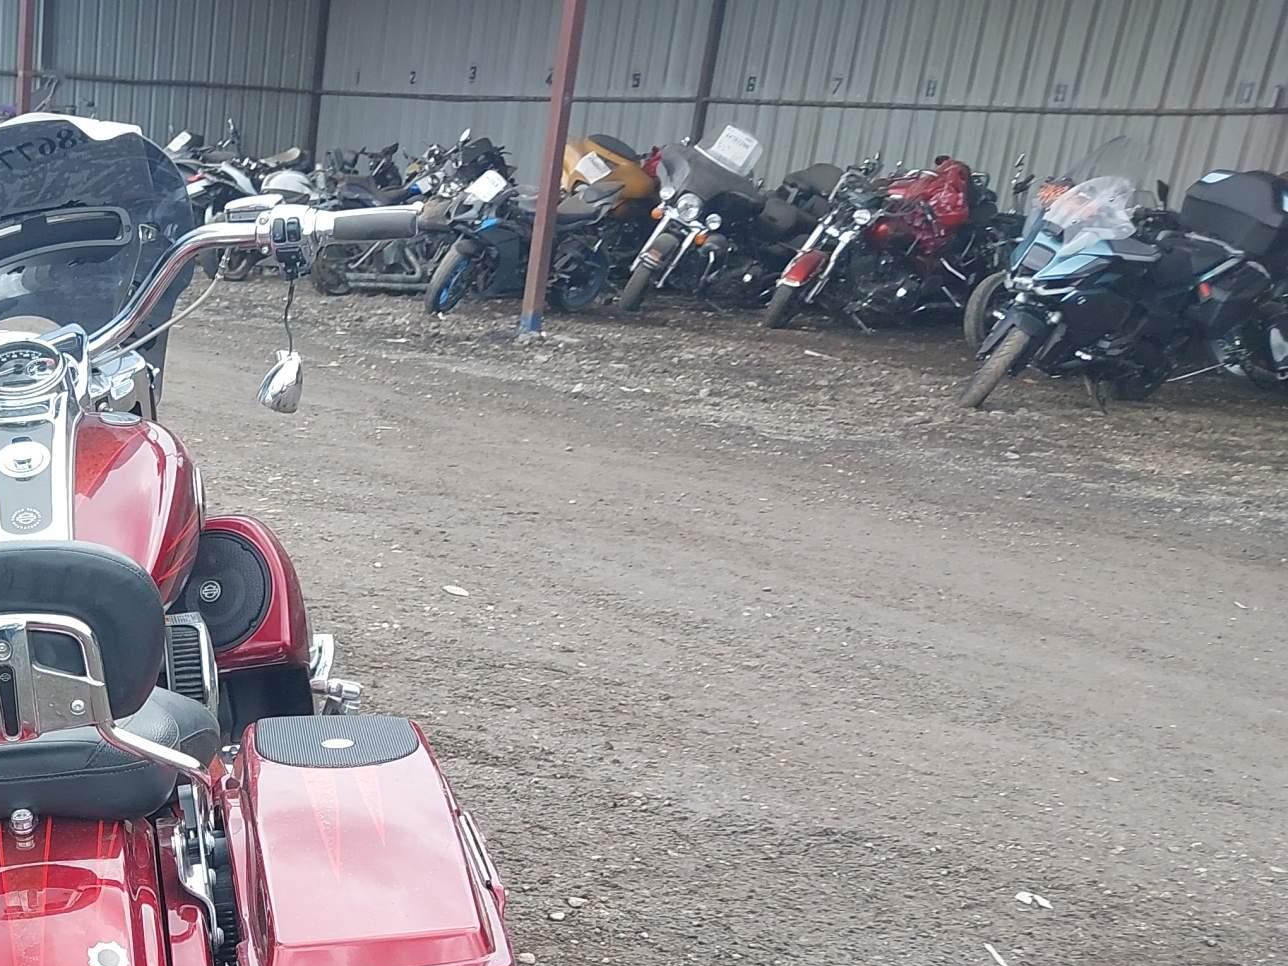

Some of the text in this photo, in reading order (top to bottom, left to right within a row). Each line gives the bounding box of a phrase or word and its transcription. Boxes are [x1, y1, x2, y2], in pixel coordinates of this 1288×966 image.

[409, 71, 417, 85] 2
[468, 65, 478, 84] 3
[631, 72, 642, 88] 5
[746, 76, 758, 92] 6
[831, 77, 844, 95] 7
